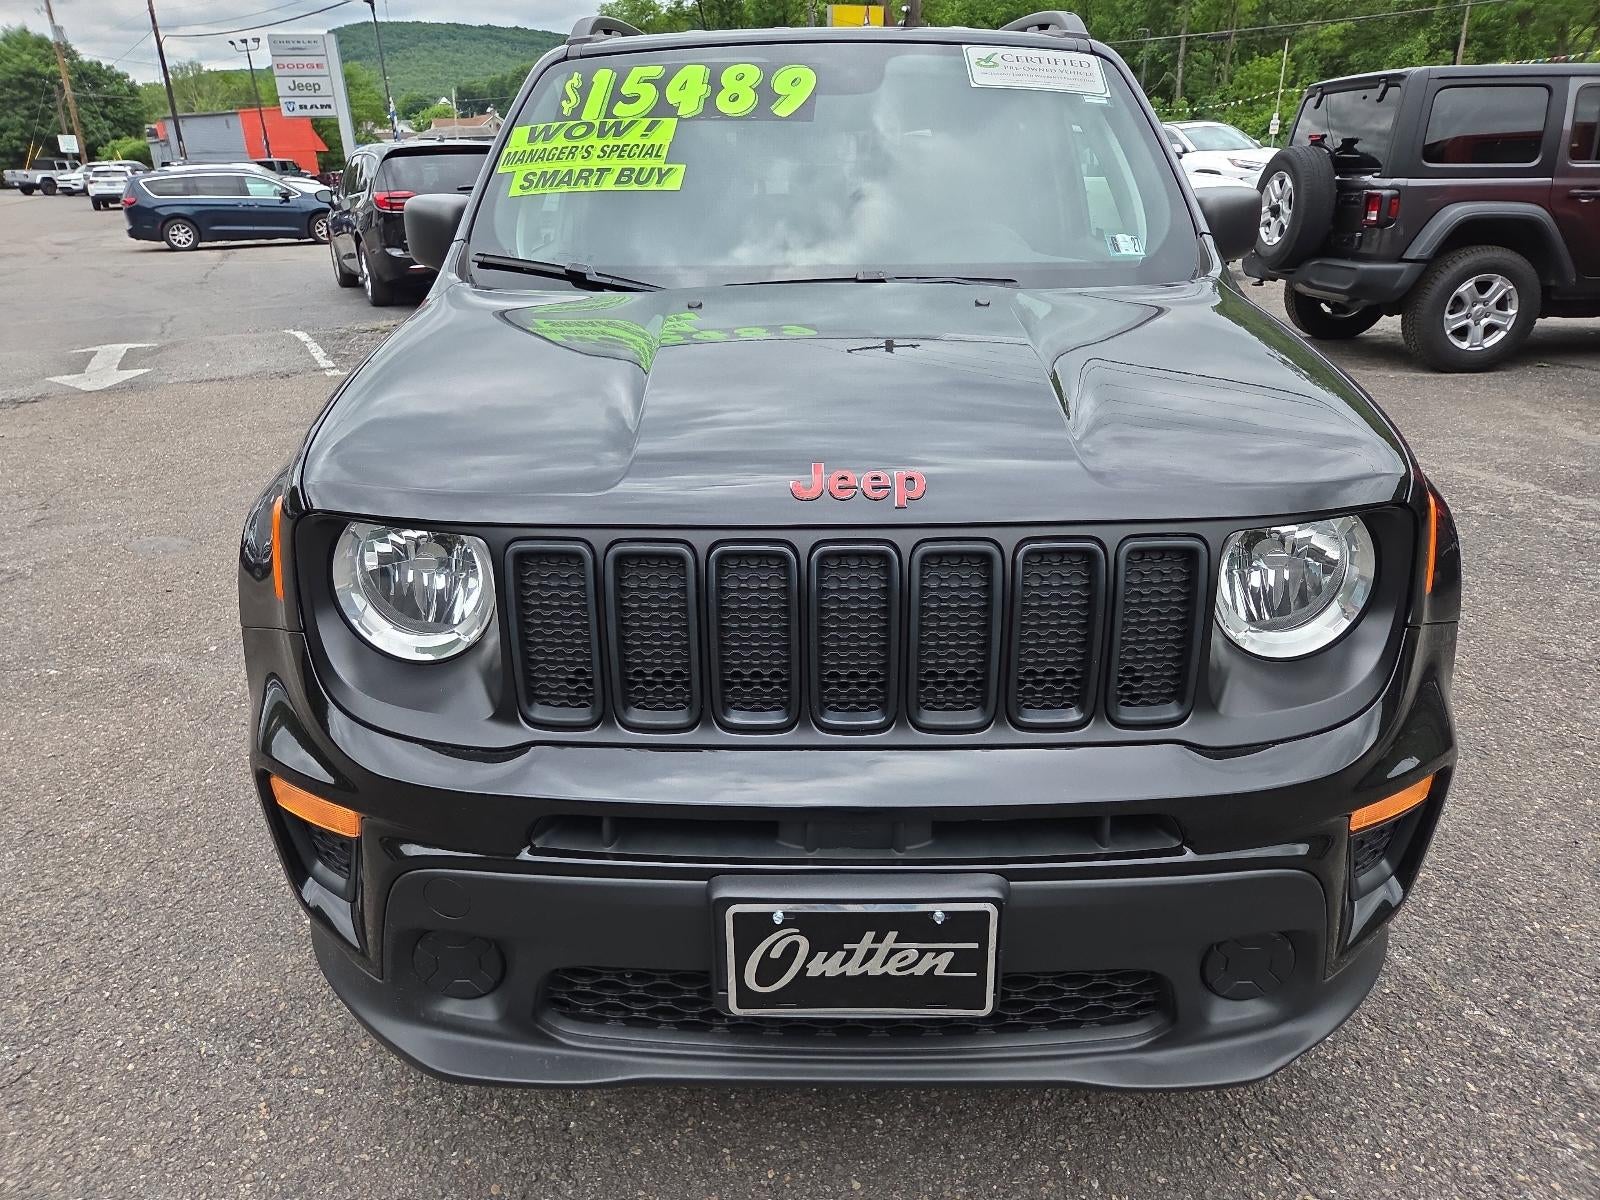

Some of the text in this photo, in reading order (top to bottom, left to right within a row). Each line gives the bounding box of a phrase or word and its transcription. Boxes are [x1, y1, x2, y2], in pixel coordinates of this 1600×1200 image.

[1001, 54, 1091, 69] CERTIFIED
[288, 79, 321, 94] Jeep
[561, 63, 818, 119] $15489
[501, 143, 664, 167] MANAGER'S SPECIAL
[519, 166, 678, 191] SMART BUY
[789, 462, 927, 509] Jeep
[744, 928, 979, 993] Outten
